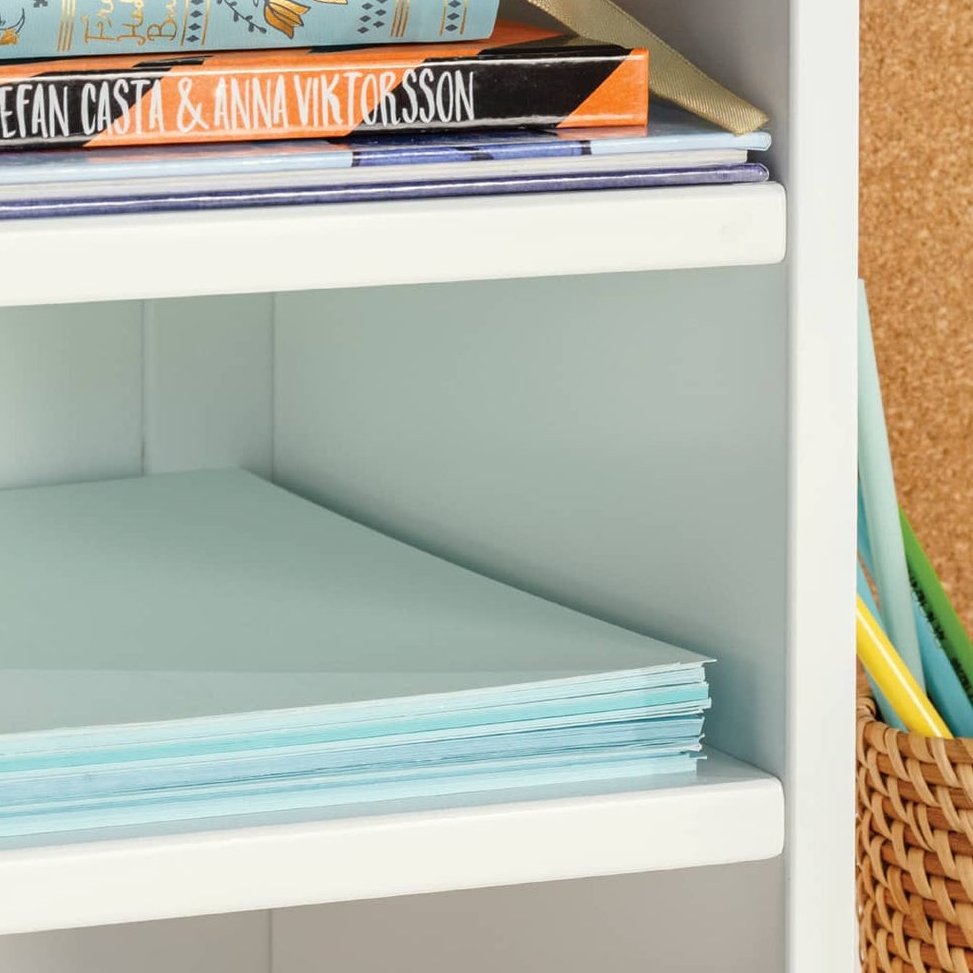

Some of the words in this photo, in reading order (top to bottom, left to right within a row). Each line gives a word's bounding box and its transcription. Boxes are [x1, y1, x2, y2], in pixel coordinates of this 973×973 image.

[81, 78, 165, 136] CASTA
[176, 77, 209, 133] &
[214, 75, 289, 130] ANNA
[293, 68, 476, 127] VIKTORSSON
